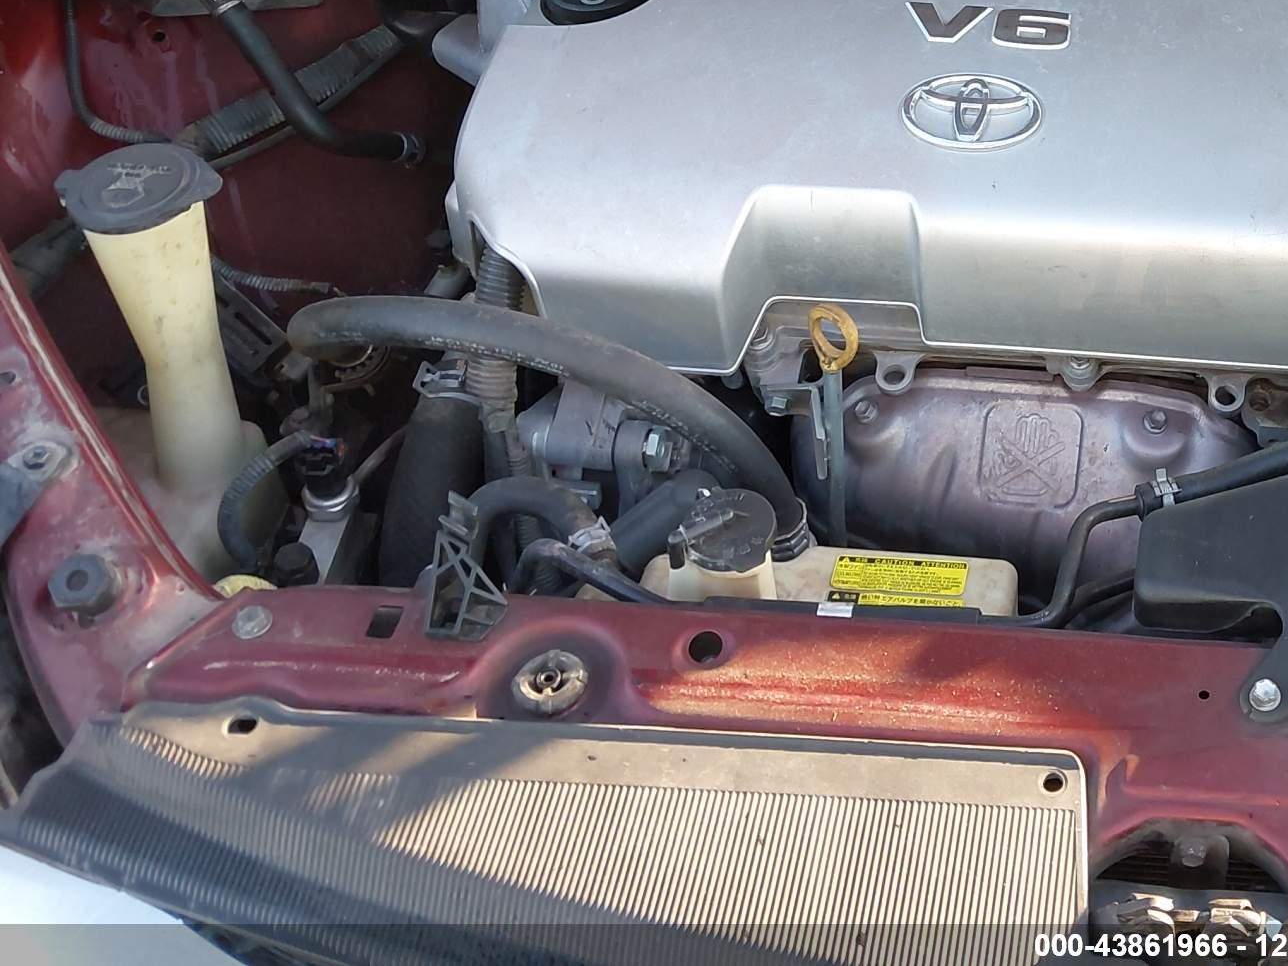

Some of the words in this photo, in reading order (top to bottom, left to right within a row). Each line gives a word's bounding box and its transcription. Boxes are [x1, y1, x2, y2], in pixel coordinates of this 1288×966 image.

[905, 1, 1072, 50] V6
[874, 558, 915, 566] CAUTION
[920, 560, 965, 570] ATTENTION
